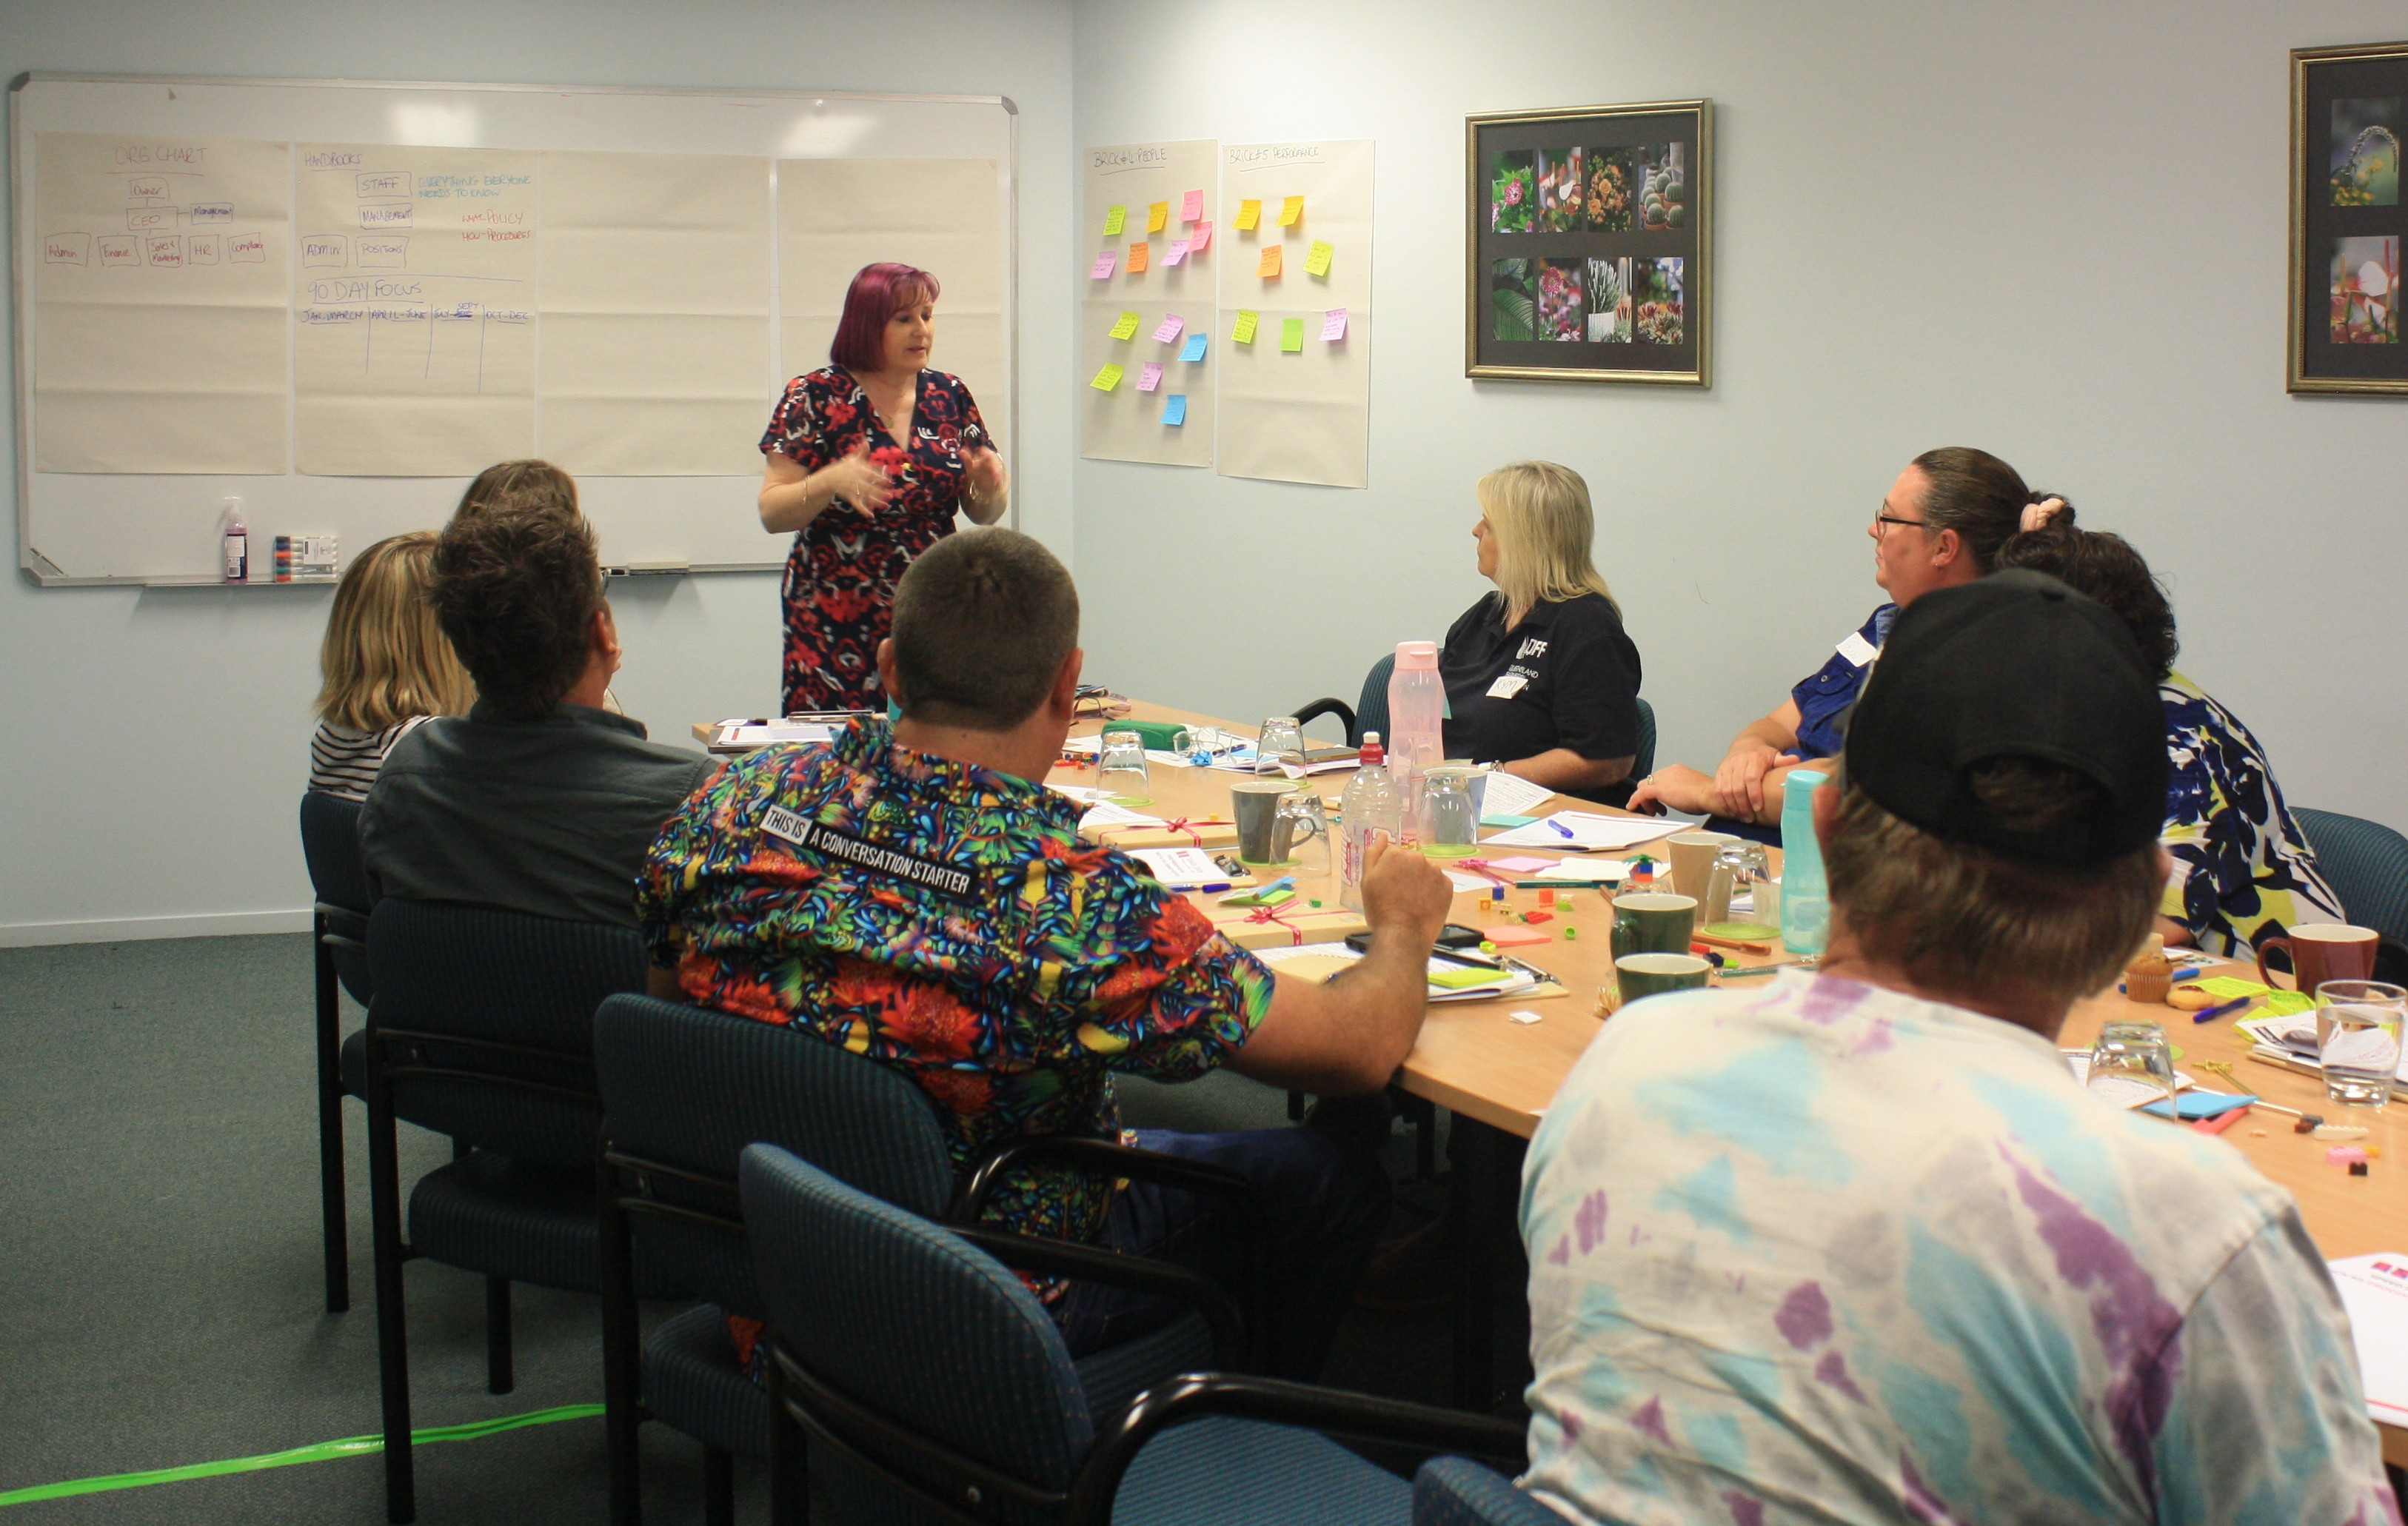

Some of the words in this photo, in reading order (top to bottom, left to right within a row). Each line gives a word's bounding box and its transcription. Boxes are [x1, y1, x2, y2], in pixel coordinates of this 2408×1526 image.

[115, 146, 150, 164] ORG
[155, 146, 207, 163] CHART
[1094, 152, 1120, 167] BRICK
[1229, 149, 1256, 164] BRICK
[133, 185, 162, 195] Owner
[362, 177, 400, 191] STAFF
[418, 189, 450, 198] NEEDS
[454, 188, 468, 198] TO
[470, 188, 501, 198] KNOW
[130, 215, 161, 227] CEO
[362, 210, 412, 223] MANAGEMENT
[195, 244, 212, 256] HR
[307, 244, 341, 256] ADMIN
[308, 282, 329, 299] 90
[335, 281, 369, 301] DAY
[374, 279, 422, 296] FOCUS
[766, 810, 793, 833] THIS
[791, 820, 806, 838] IS
[809, 830, 820, 845] A
[820, 834, 914, 877] CONVERSATION
[911, 862, 971, 894] STARTER
